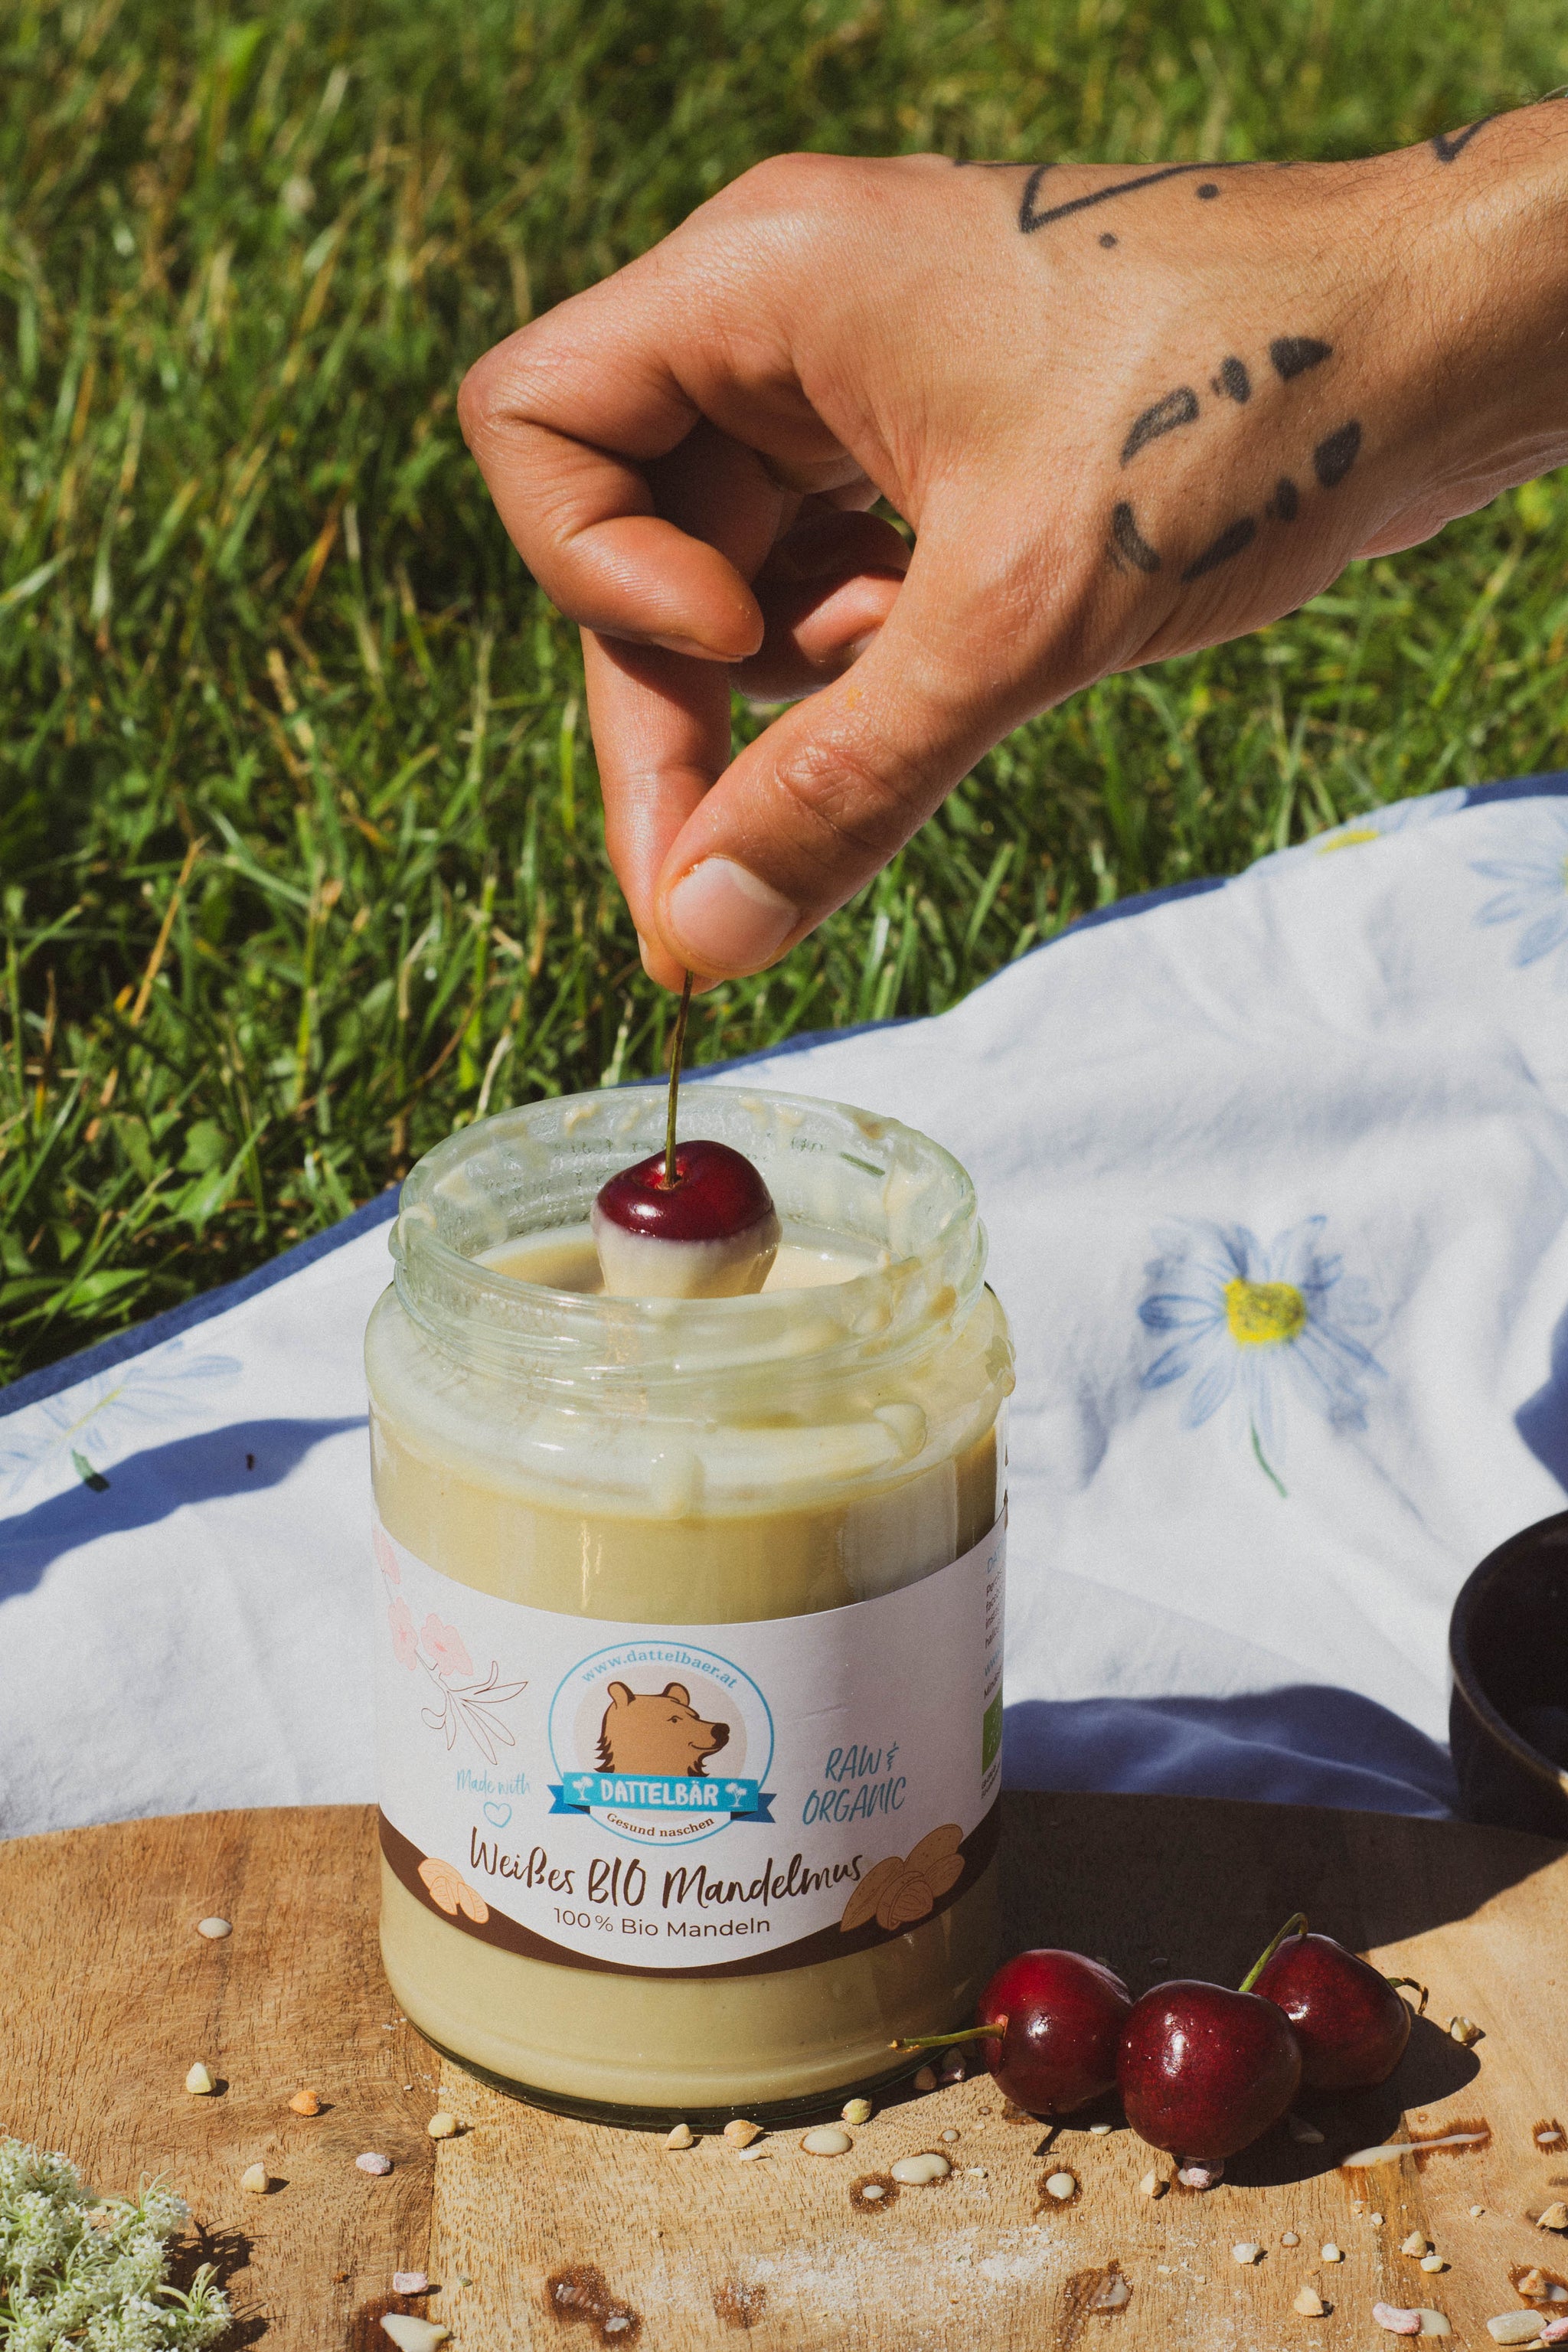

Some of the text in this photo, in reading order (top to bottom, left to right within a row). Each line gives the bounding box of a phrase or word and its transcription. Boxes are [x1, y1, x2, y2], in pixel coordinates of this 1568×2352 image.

[581, 1649, 739, 1690] www.dattelbaer.at
[825, 1744, 882, 1782] RAW
[456, 1769, 531, 1796] Made with
[600, 1779, 719, 1807] DATTELBÄR
[802, 1775, 907, 1826] ORGANIC
[606, 1812, 715, 1838] Gesund naschen
[470, 1825, 864, 1909] Weißes BIO Mandelmus
[622, 1917, 659, 1937] Bio
[667, 1917, 771, 1938] Mandeln
